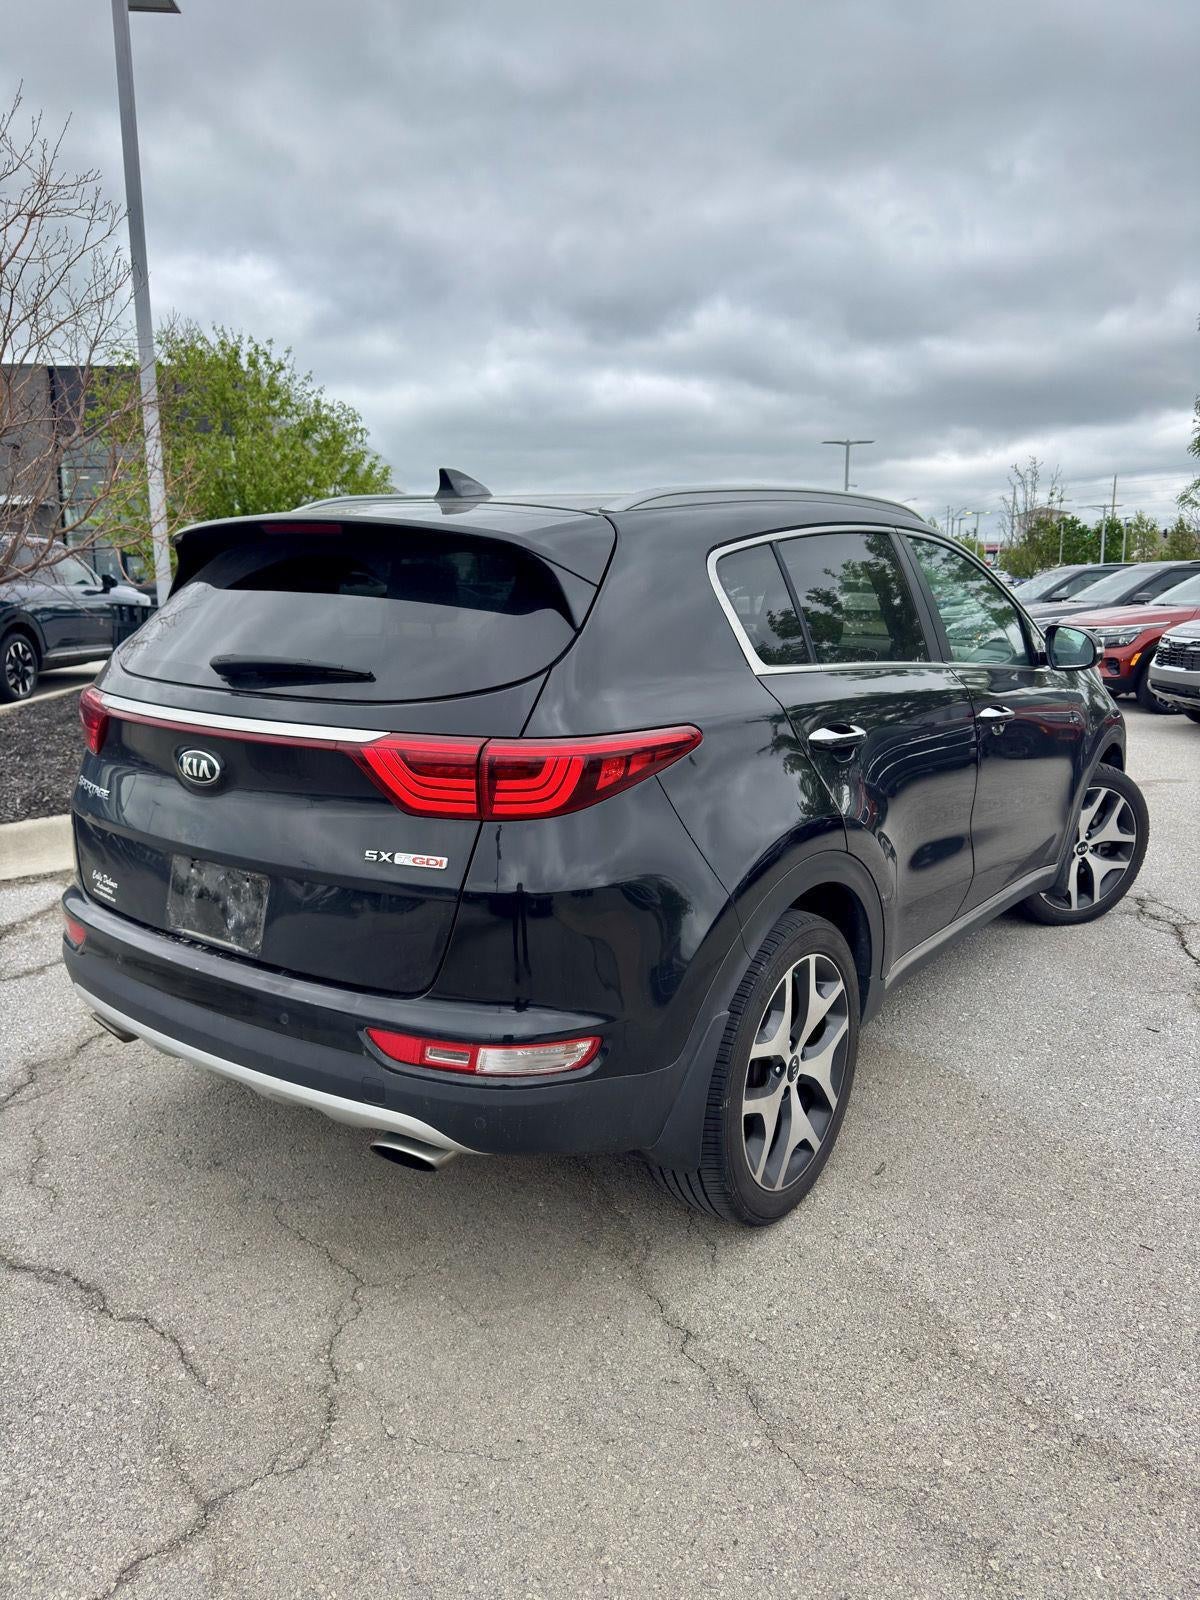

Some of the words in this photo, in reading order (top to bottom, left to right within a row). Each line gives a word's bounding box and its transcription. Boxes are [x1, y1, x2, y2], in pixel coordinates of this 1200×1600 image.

[182, 756, 212, 779] KIA
[78, 775, 111, 800] SPORTAGE
[364, 850, 393, 864] SX
